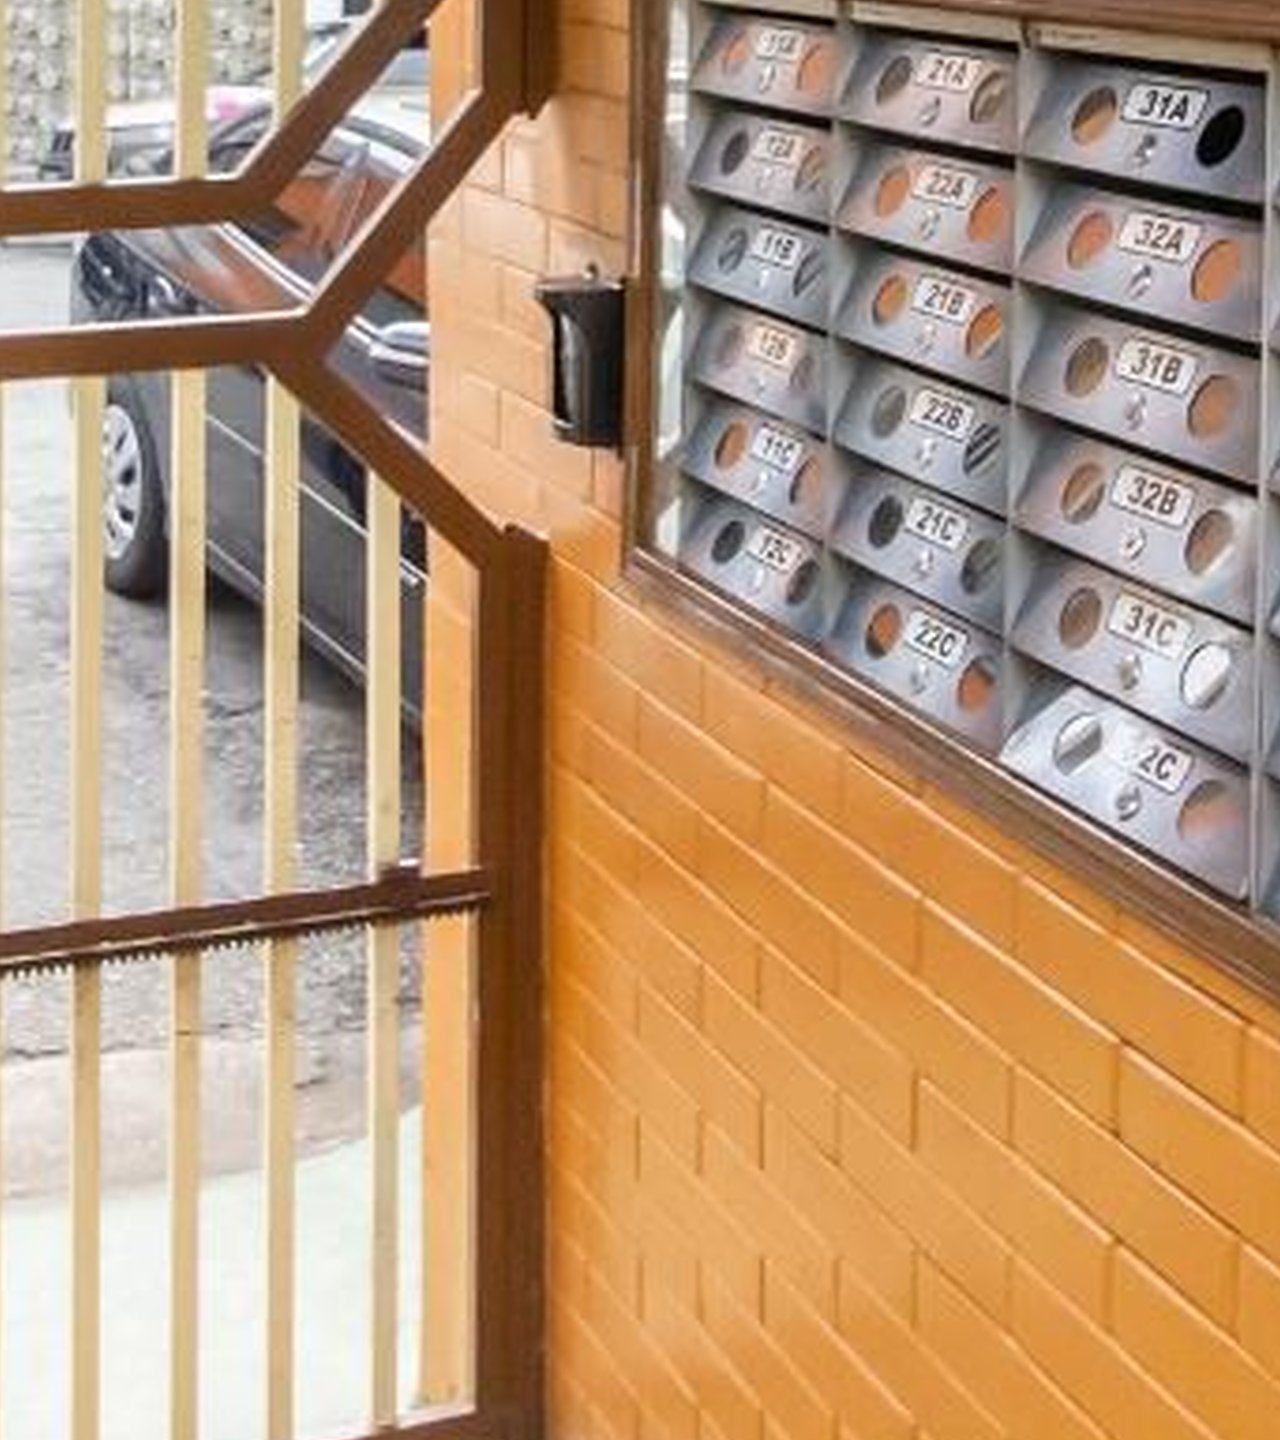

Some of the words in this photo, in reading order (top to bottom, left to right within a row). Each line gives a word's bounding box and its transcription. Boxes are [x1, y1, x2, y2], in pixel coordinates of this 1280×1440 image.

[927, 58, 968, 85] 21A
[1139, 90, 1190, 121] 31A
[926, 171, 966, 197] 22A
[1133, 221, 1186, 257] 32A
[923, 283, 965, 316] 21B
[1130, 347, 1184, 385] 31B
[922, 397, 964, 430] 22B
[1126, 475, 1180, 516] 32B
[915, 505, 958, 542] 21C
[913, 620, 958, 659] 22C
[1124, 605, 1177, 648] 31C
[1135, 743, 1178, 782] 2C
